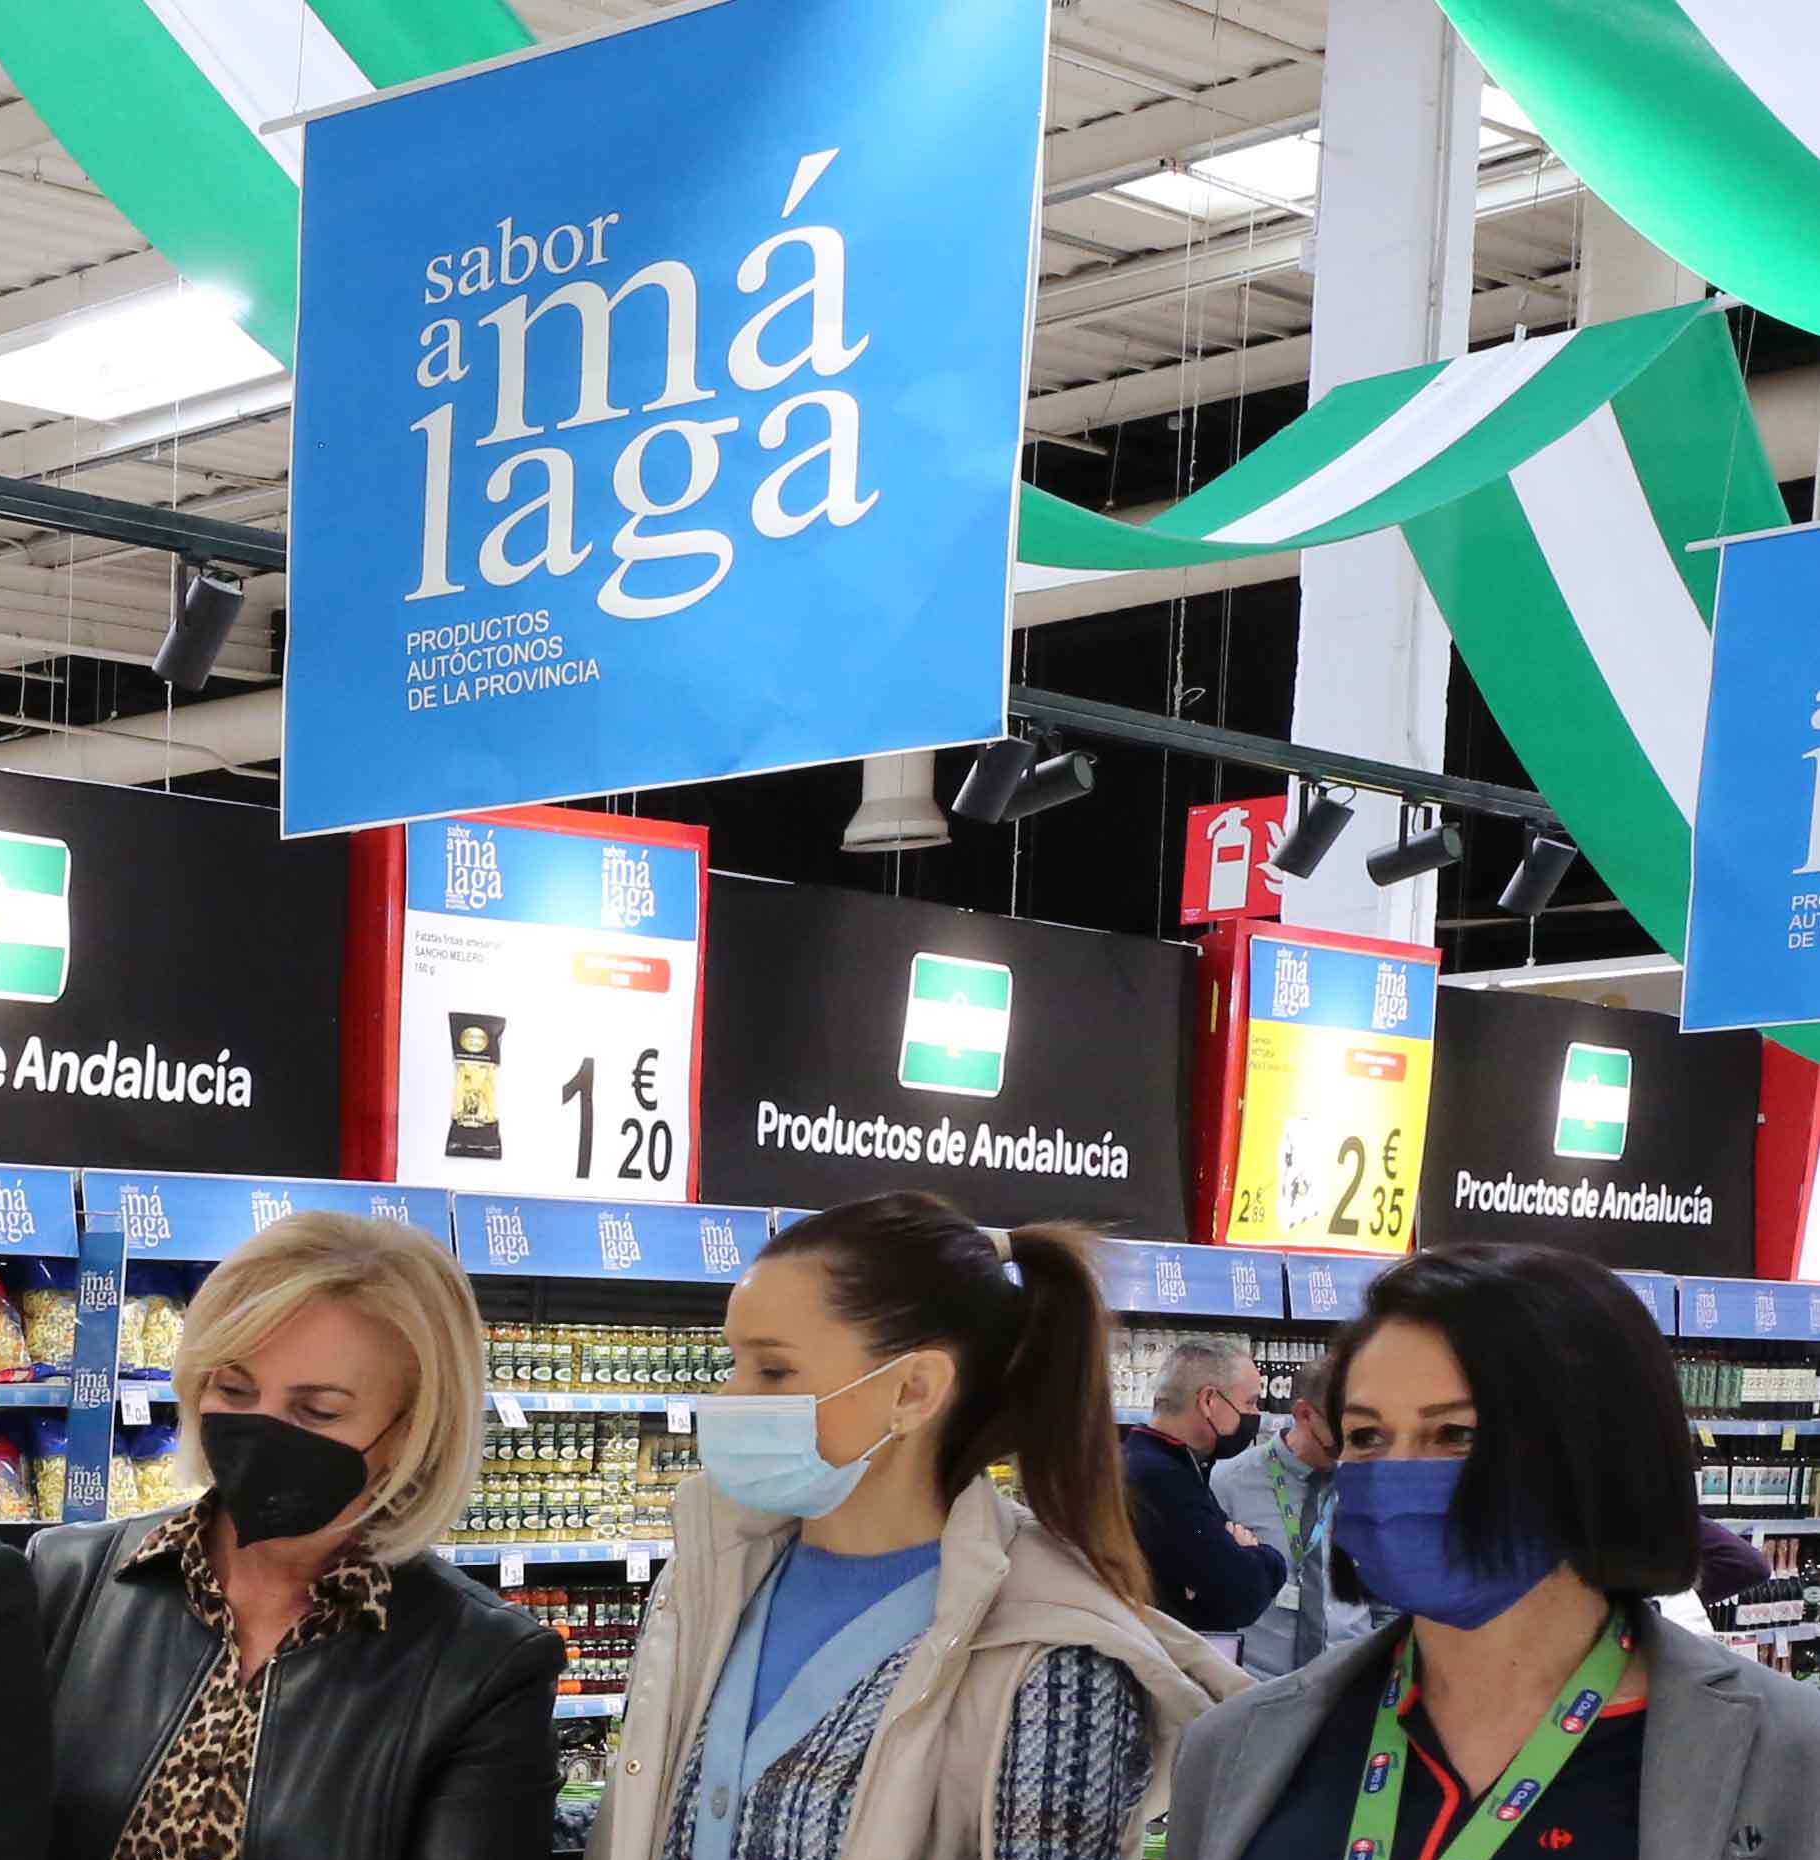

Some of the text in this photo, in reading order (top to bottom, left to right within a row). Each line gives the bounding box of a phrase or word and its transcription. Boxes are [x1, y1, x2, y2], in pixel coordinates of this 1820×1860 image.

[425, 212, 620, 306] sabor
[416, 147, 869, 448] a má
[405, 390, 880, 619] laga
[406, 609, 550, 655] PRODUCTOS
[406, 635, 563, 684] AUTÓCTONOS
[408, 657, 600, 711] DE LA PROVINCIA
[455, 829, 497, 869] má
[610, 848, 650, 888] má
[446, 852, 503, 909] laga
[601, 871, 655, 927] laga
[14, 1032, 253, 1109] Andalucía
[562, 1048, 659, 1179] 1 €
[617, 1118, 672, 1182] 20
[756, 1099, 1129, 1181] Productos de Andalucía
[1238, 1190, 1252, 1223] 2
[1328, 1128, 1402, 1236] 2 €
[1454, 1171, 1714, 1226] Productos de Andalucía
[1369, 1185, 1405, 1237] 35
[486, 1226, 529, 1264] laga
[80, 1286, 118, 1312] laga
[86, 1271, 115, 1292] má
[74, 1383, 111, 1408] laga
[80, 1368, 109, 1389] má
[67, 1477, 106, 1505] laga
[73, 1464, 102, 1486] má
